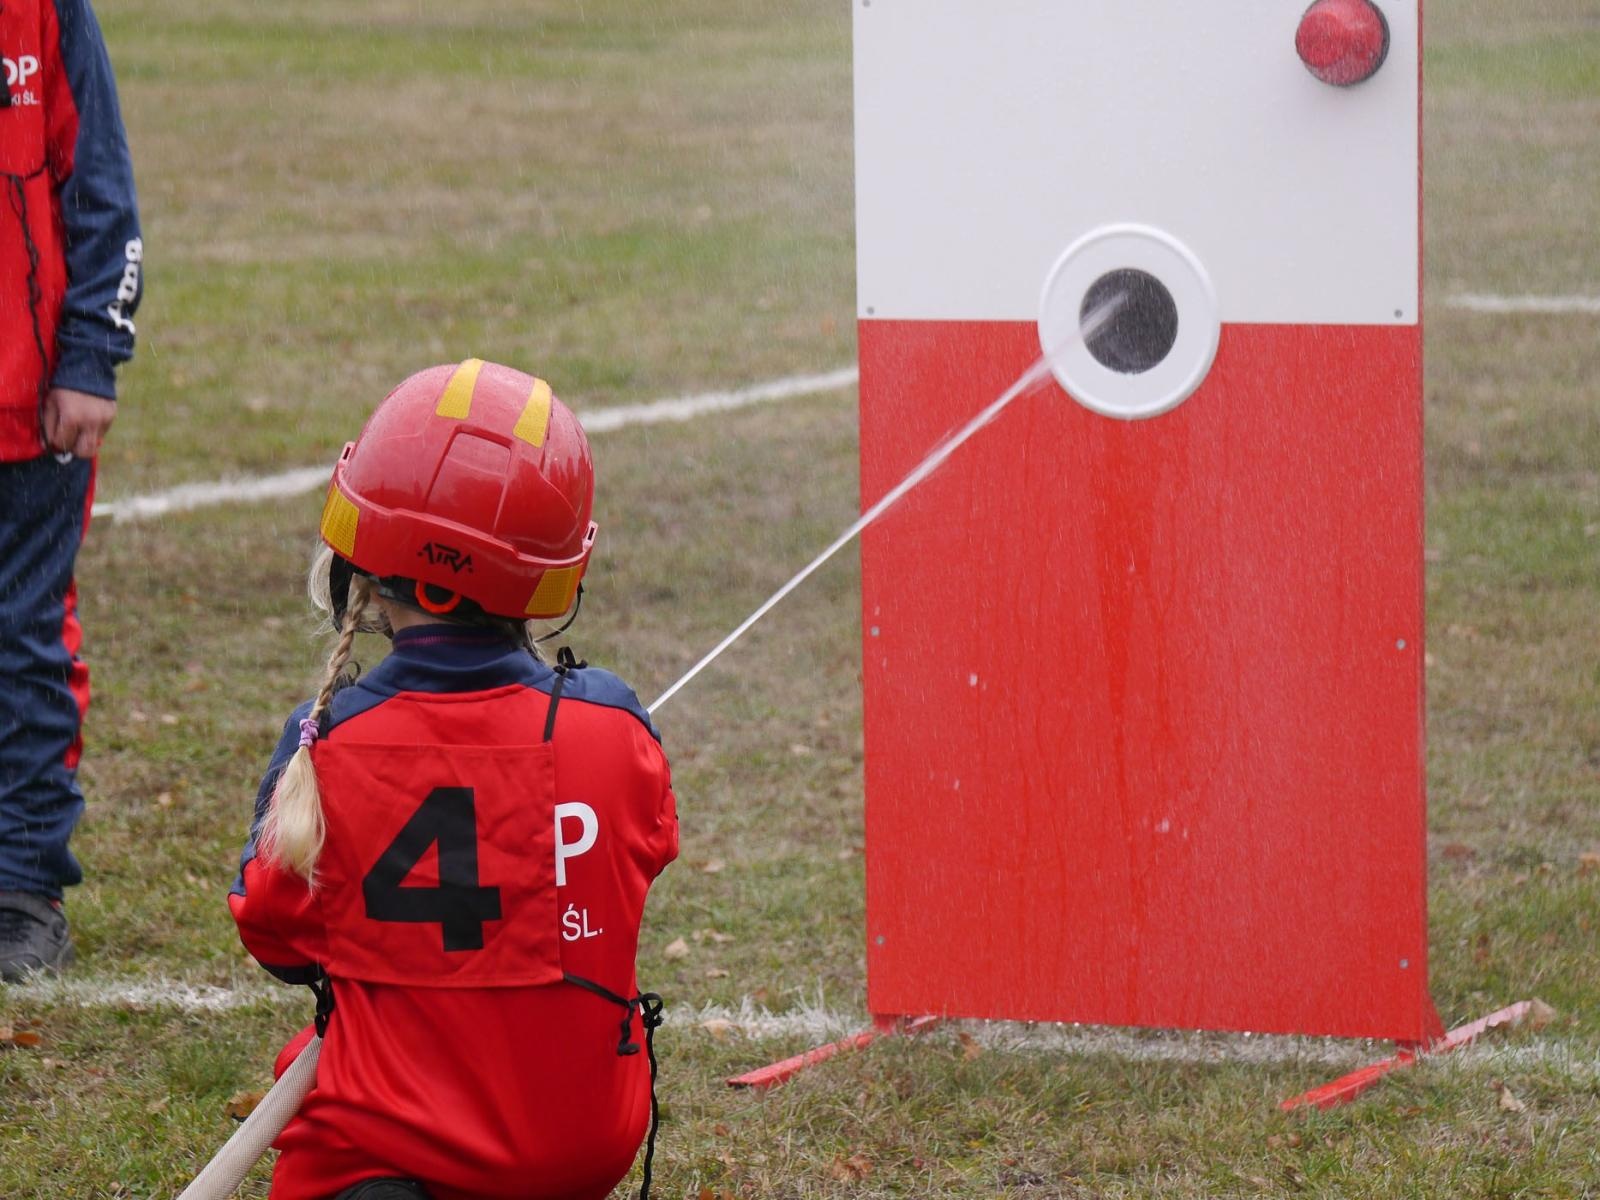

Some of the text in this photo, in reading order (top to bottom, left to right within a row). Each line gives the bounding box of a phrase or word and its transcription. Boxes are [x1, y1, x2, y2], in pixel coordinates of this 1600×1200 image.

[362, 786, 502, 952] 4
[554, 802, 599, 886] P
[562, 903, 603, 941] ŚL.
